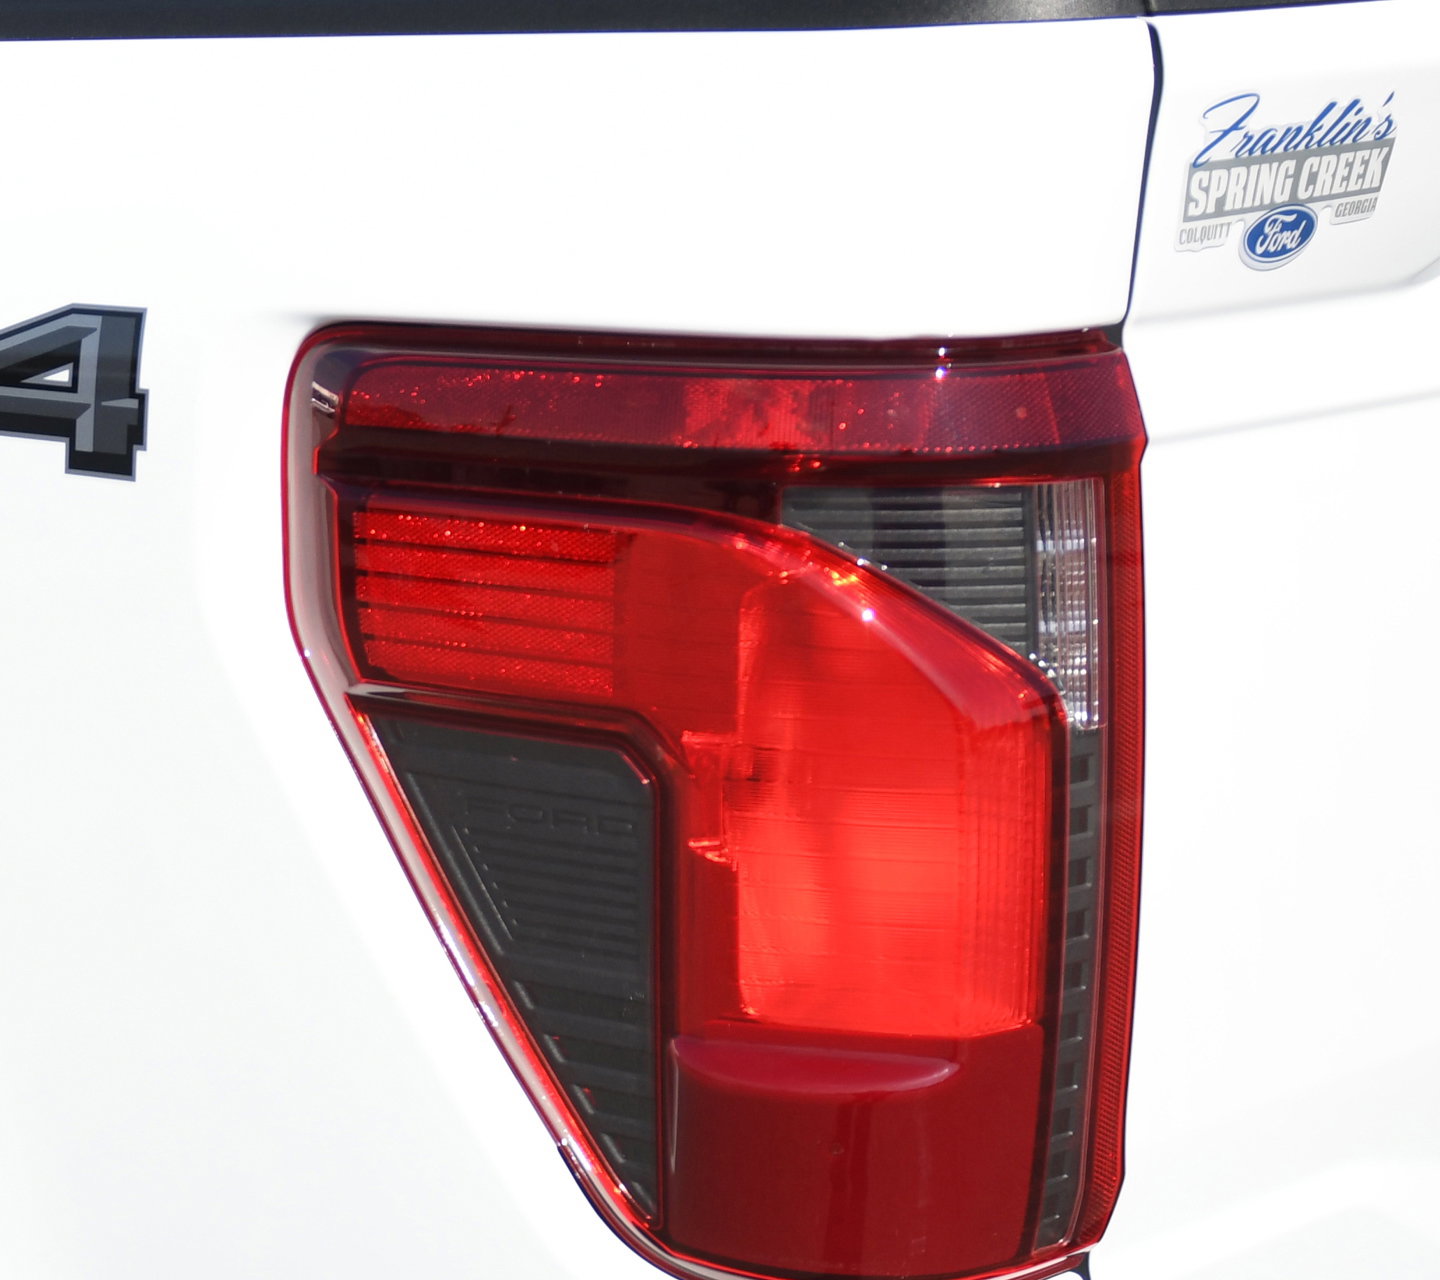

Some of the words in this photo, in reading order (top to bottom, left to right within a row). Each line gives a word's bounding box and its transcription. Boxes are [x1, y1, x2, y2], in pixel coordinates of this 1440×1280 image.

[1191, 89, 1397, 168] Franklin's
[1187, 158, 1295, 218] SPRING
[1296, 145, 1390, 201] CREEK
[1334, 196, 1379, 219] GEORGIA
[1178, 220, 1232, 246] COLQUITT
[1256, 211, 1310, 256] Ford
